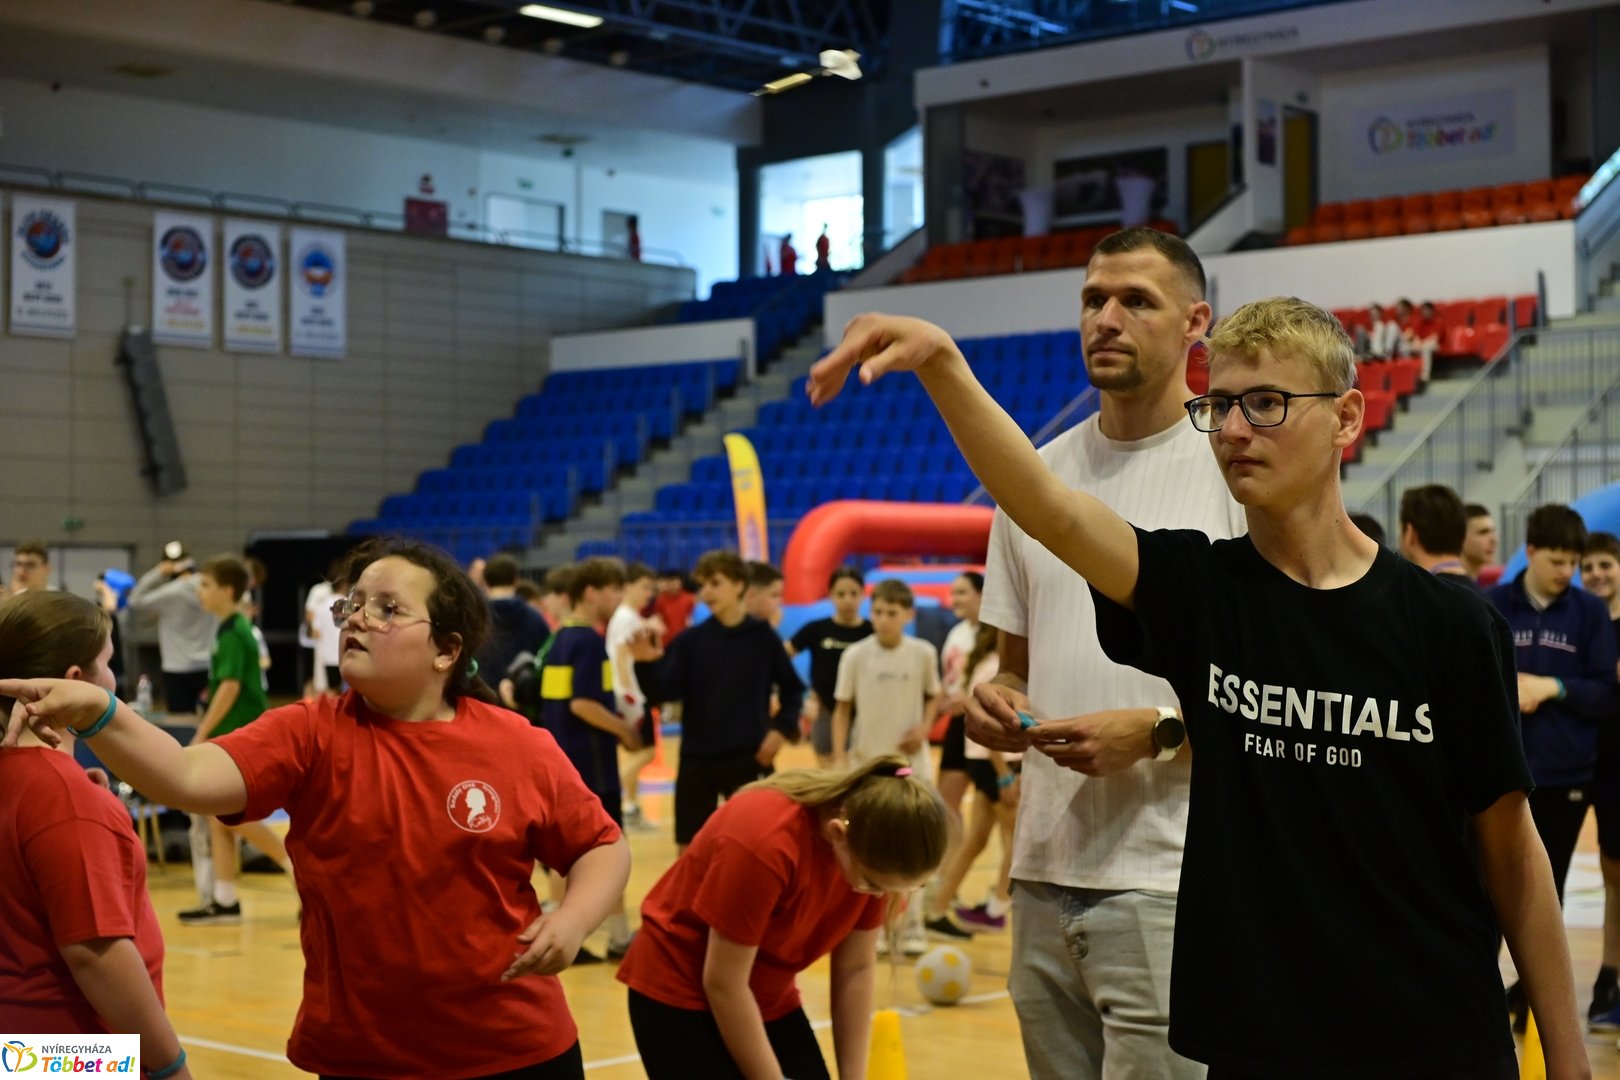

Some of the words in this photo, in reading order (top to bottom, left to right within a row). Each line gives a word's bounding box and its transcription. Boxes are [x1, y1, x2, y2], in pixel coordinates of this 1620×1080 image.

[1208, 663, 1434, 743] ESSENTIALS
[1245, 733, 1286, 759] FEAR
[1294, 742, 1317, 763] OF
[1326, 746, 1362, 768] GOD
